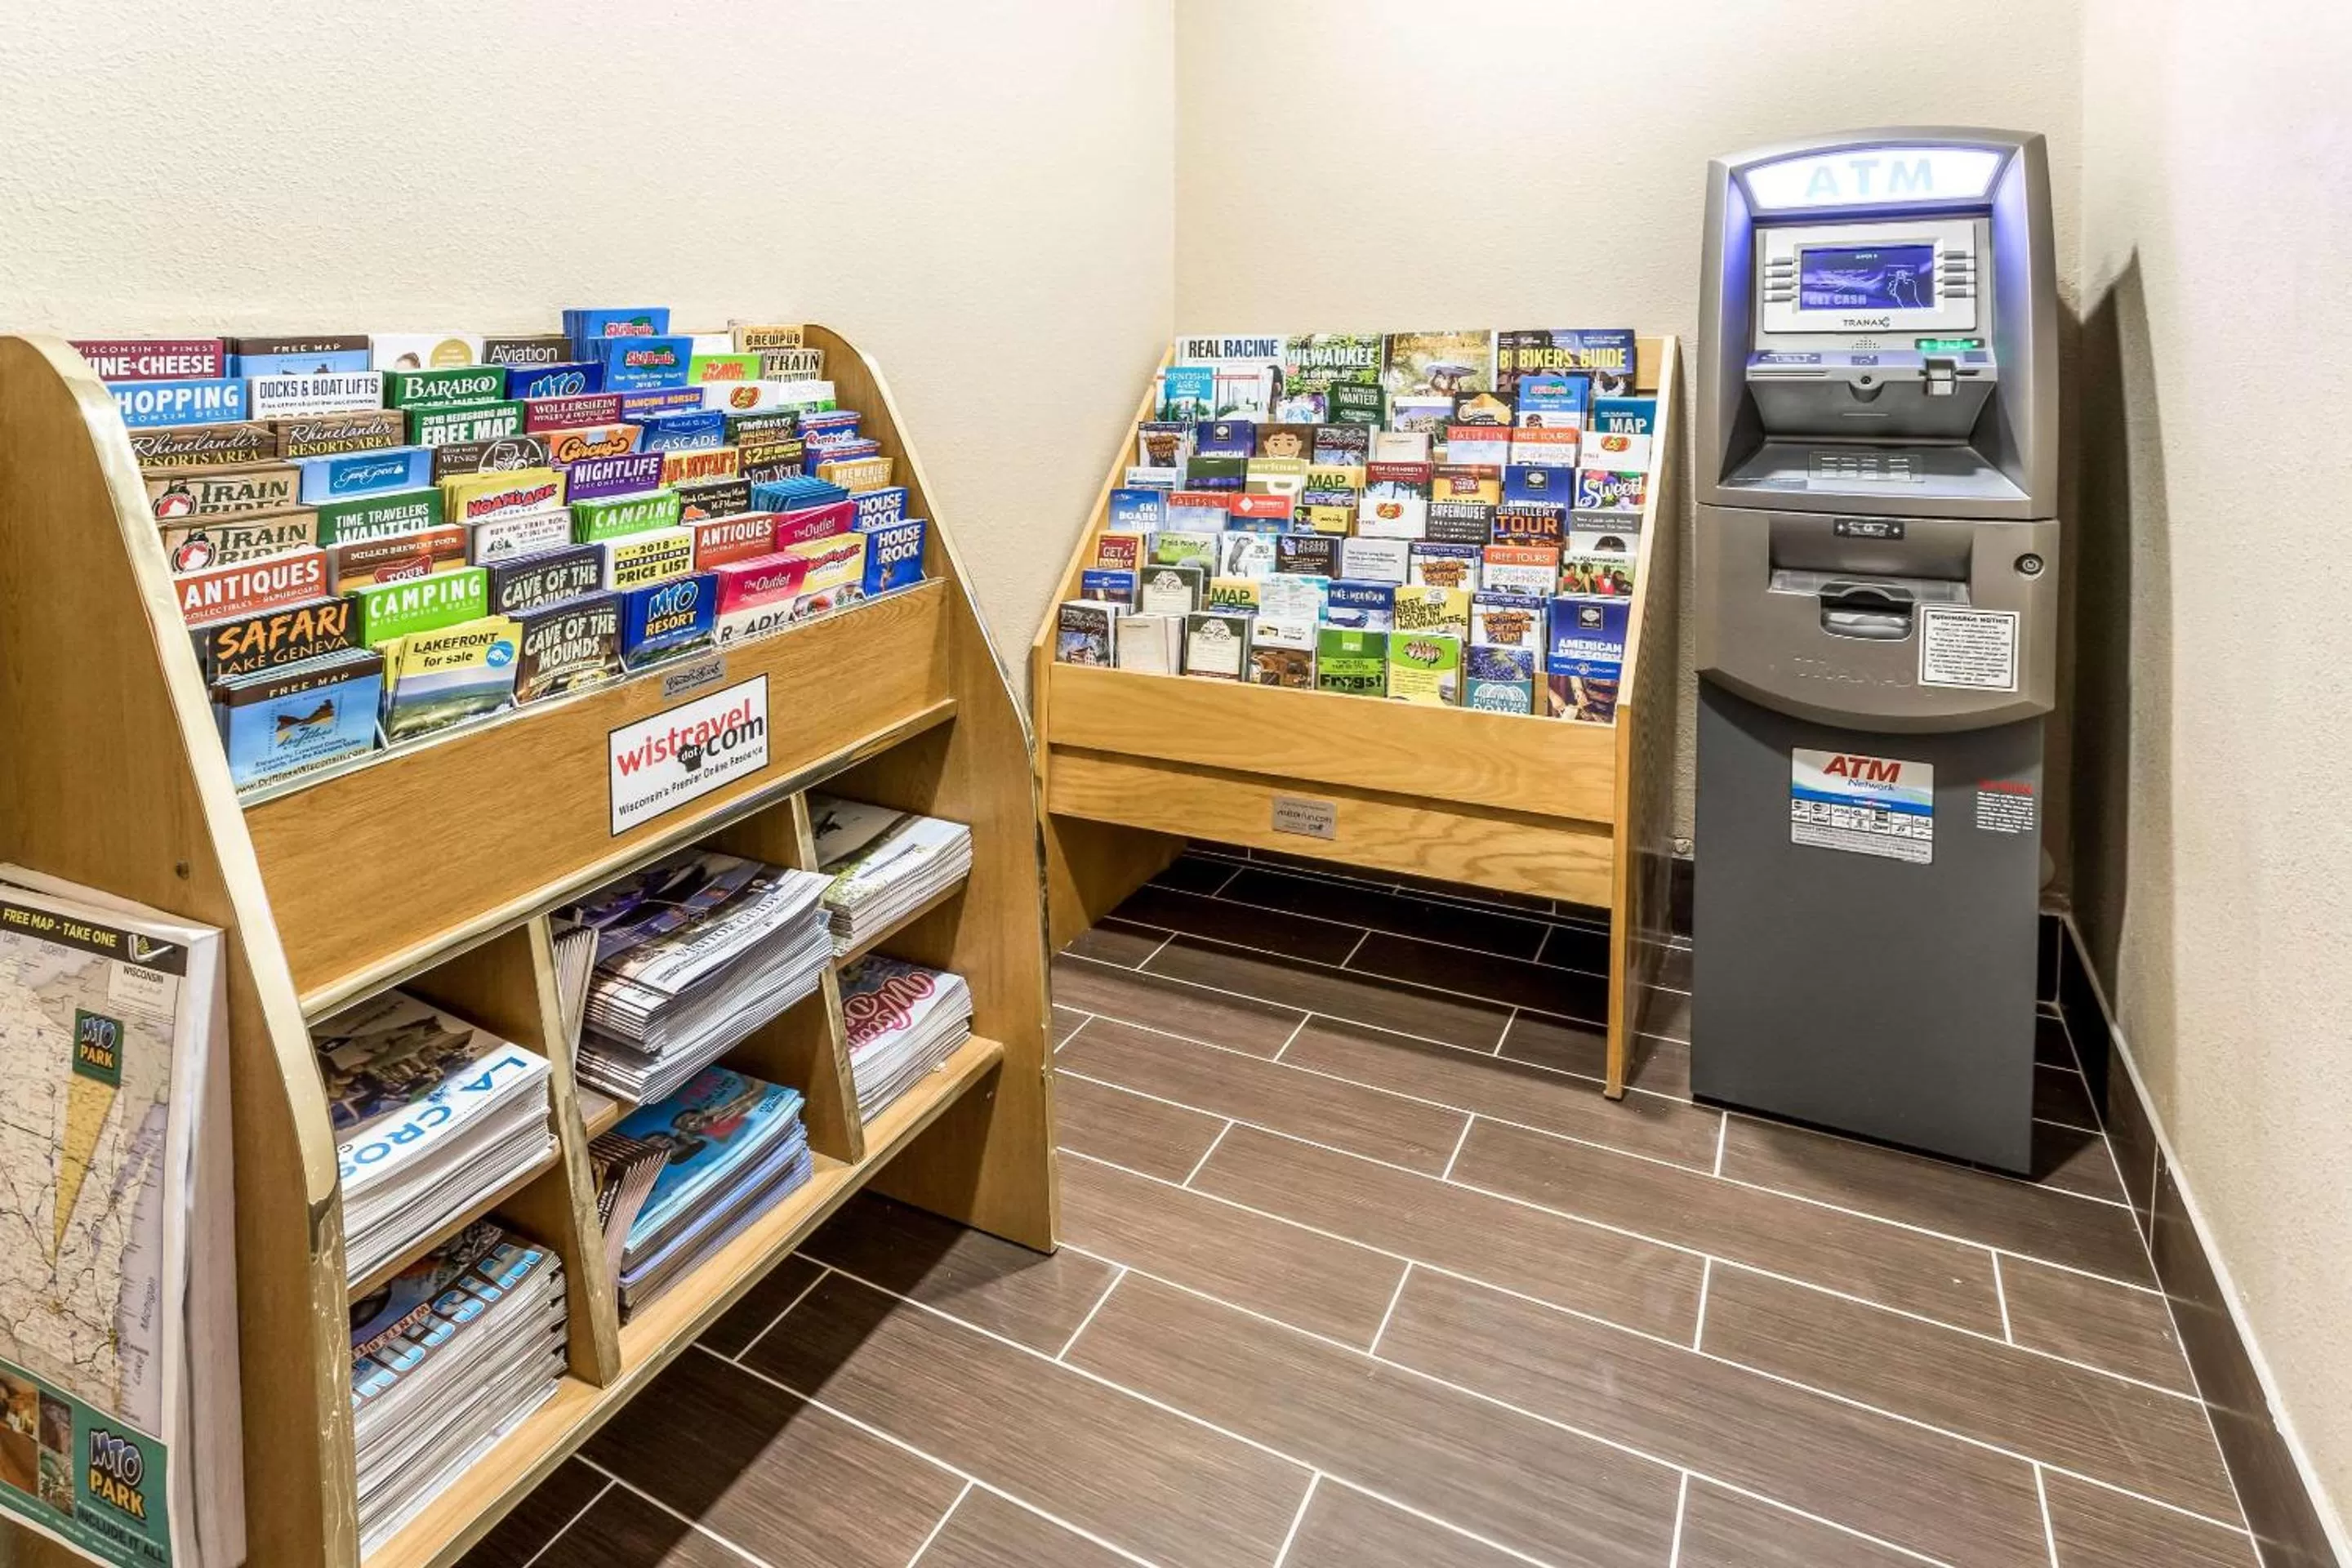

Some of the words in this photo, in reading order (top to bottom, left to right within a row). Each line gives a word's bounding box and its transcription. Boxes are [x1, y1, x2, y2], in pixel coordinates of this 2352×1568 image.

[1804, 158, 1934, 198] ATM
[1833, 293, 1868, 305] CASH
[1843, 318, 1884, 327] TRANAX
[314, 343, 342, 352] MAP
[745, 334, 801, 346] BREWPUB
[1188, 339, 1223, 359] REAL
[1224, 339, 1279, 358] RACINE
[491, 343, 558, 363] Aviation
[766, 354, 820, 372] TRAIN
[1285, 347, 1374, 367] MILWAUKEE
[1519, 350, 1574, 368] BIKERS
[1579, 348, 1627, 368] GUIDE
[260, 380, 297, 399] DOCKS
[301, 381, 310, 395] &
[313, 378, 344, 396] BOAT
[345, 376, 378, 395] LIFTS
[1165, 372, 1212, 382] KENOSHA
[1176, 381, 1202, 390] AREA
[404, 376, 498, 400] BARABOO
[661, 392, 701, 405] HORSES
[117, 385, 240, 415] HOPPING
[535, 398, 616, 413] WOLLERSHEIM
[1338, 393, 1379, 406] WANTED!
[289, 416, 394, 446] Rhinelander
[421, 420, 470, 446] FREE
[473, 417, 517, 440] MAP
[1610, 417, 1647, 434] MAP
[134, 428, 263, 457] Rhinelander
[287, 435, 348, 457] RESORTS
[350, 434, 394, 450] AREA
[559, 437, 630, 464] Circus
[652, 434, 718, 452] CASCADE
[212, 449, 259, 464] AREA
[745, 448, 764, 463] $2
[574, 457, 661, 484] NIGHTLIFE
[1307, 474, 1347, 488] MAP
[201, 479, 290, 505] TRAIN
[519, 483, 558, 506] ARK
[595, 499, 677, 528] CAMPING
[859, 492, 902, 514] HOUSE
[1139, 503, 1158, 512] SKI
[1430, 505, 1486, 519] SAFEHOUSE
[1495, 506, 1558, 518] DISTILLERY
[335, 514, 364, 529] TIME
[368, 503, 430, 523] TRAVELERS
[863, 508, 901, 529] ROCK
[1118, 510, 1158, 522] BOARD
[1497, 516, 1559, 534] TOUR
[219, 523, 308, 551] TRAIN
[701, 518, 773, 547] ANTIQUES
[878, 524, 921, 547] HOUSE
[350, 548, 389, 561] MILLER
[639, 540, 670, 555] 2018
[879, 542, 919, 564] ROCK
[1102, 546, 1121, 559] GET
[1489, 552, 1512, 562] FREE
[616, 565, 658, 586] PRICE
[662, 559, 689, 577] LIST
[755, 572, 791, 593] Outlet
[184, 559, 321, 612] ANTIQUES
[501, 577, 545, 607] CAVE
[546, 572, 568, 590] OF
[570, 564, 598, 585] THE
[1211, 587, 1251, 604] MAP
[370, 574, 482, 620] CAMPING
[370, 605, 439, 628] WISCONSIN
[645, 610, 697, 637] RESORT
[1397, 610, 1428, 622] TOUR
[1428, 609, 1441, 619] IN
[216, 603, 350, 659] SAFARI
[524, 627, 562, 657] CAVE
[564, 620, 586, 640] OF
[587, 614, 617, 637] THE
[413, 632, 499, 653] LAKEFRONT
[1558, 639, 1623, 653] AMERICAN
[216, 657, 266, 677] LAKE
[277, 636, 350, 663] GENEVA
[423, 655, 443, 667] for
[445, 652, 474, 665] sale
[537, 636, 601, 674] MOUNDS
[269, 683, 311, 698] FREE
[318, 672, 350, 688] MAP
[1320, 673, 1383, 691] Frogs!
[617, 698, 752, 777] wistravel
[705, 715, 764, 757] com
[1824, 755, 1902, 784] ATM
[618, 785, 670, 817] Wisconsin's
[670, 775, 702, 793] Premier
[703, 764, 728, 780] Online
[729, 746, 764, 768] Resource
[1847, 777, 1895, 792] Network
[2, 907, 30, 925] FREE
[30, 914, 55, 932] MAP
[62, 922, 91, 941] TAKE
[91, 929, 118, 948] ONE
[122, 964, 164, 984] WISCONSIN
[79, 1043, 115, 1069] PARK
[459, 1055, 528, 1093] LA
[351, 1242, 545, 1409] WISCON
[88, 1469, 146, 1520] PARK
